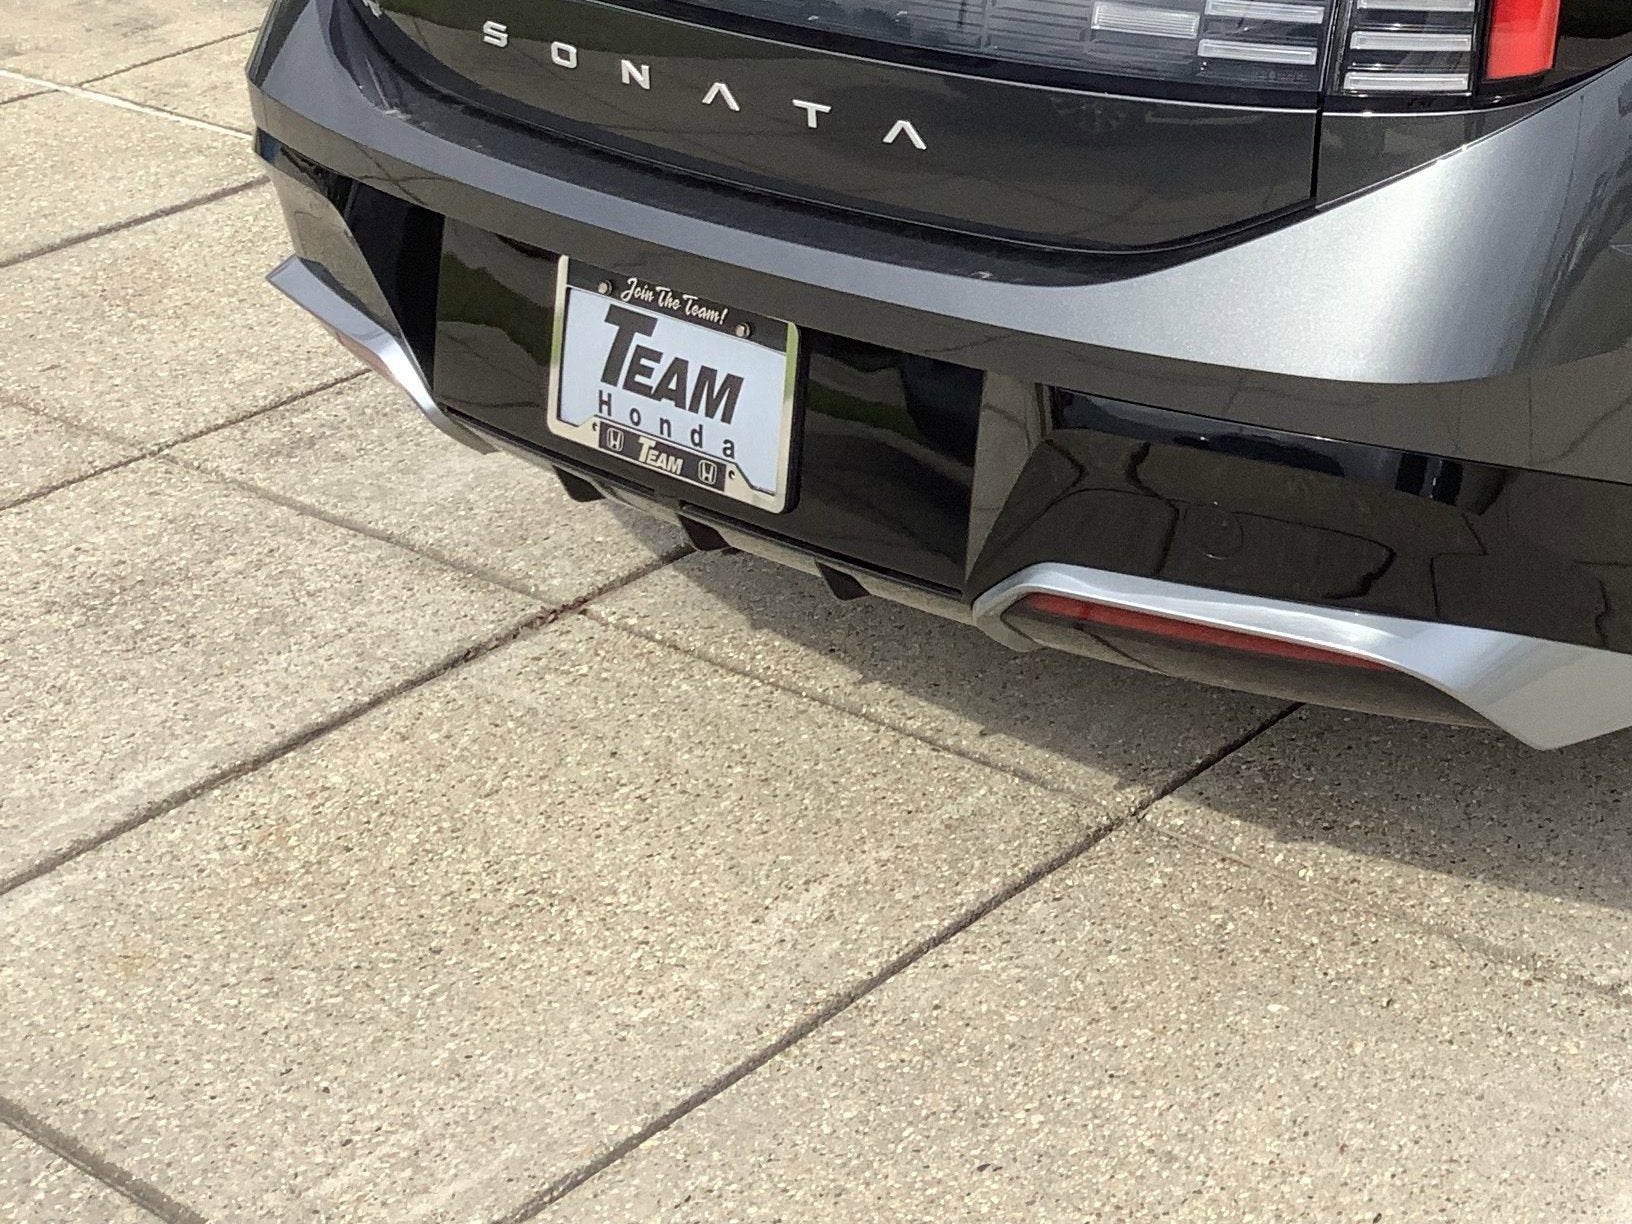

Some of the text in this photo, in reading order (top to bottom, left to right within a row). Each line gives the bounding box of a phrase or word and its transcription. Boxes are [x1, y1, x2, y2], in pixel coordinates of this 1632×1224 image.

[483, 20, 927, 151] SONATA
[620, 277, 728, 325] Join The Team!
[600, 303, 744, 425] TEAM
[598, 390, 735, 460] Honda
[638, 435, 683, 475] TEAM
